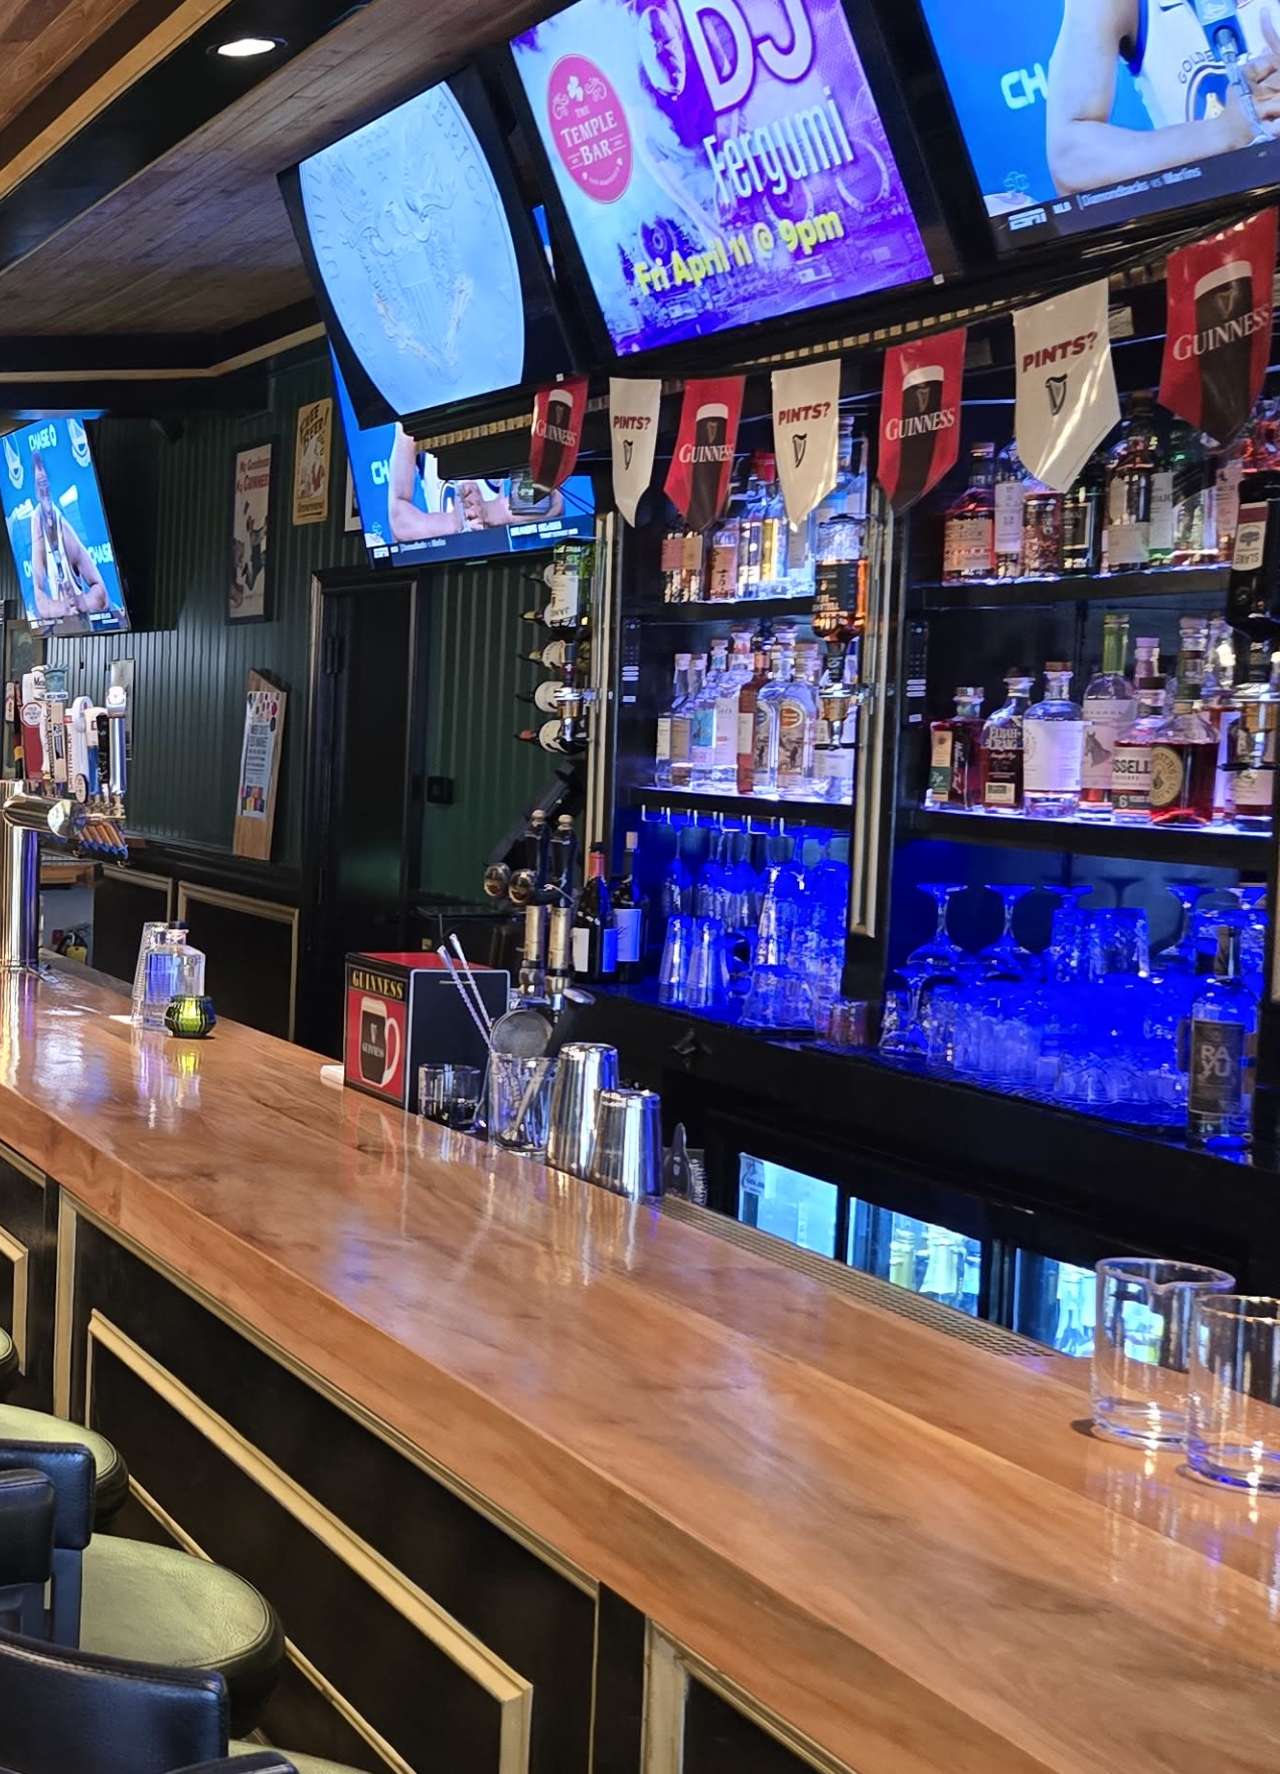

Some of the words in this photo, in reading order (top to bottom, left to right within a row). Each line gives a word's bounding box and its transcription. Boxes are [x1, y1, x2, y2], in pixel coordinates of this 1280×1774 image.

[1178, 49, 1215, 84] GOLDE
[560, 110, 618, 148] TEMPLE
[703, 86, 855, 204] Fergumi
[579, 139, 613, 167] BAR
[634, 257, 670, 295] Fri
[669, 240, 731, 288] April
[729, 233, 753, 266] 11
[752, 222, 775, 252] @
[778, 211, 845, 256] 9pm
[1172, 303, 1272, 361] GUINNESS
[1022, 331, 1098, 373] PINTS?
[613, 415, 651, 431] PINTS?
[778, 401, 831, 427] PINTS?
[885, 407, 956, 441] GUINNESS
[536, 417, 578, 448] GUINNESS
[679, 443, 735, 463] GUINNESS
[352, 969, 404, 1001] GUINNESS
